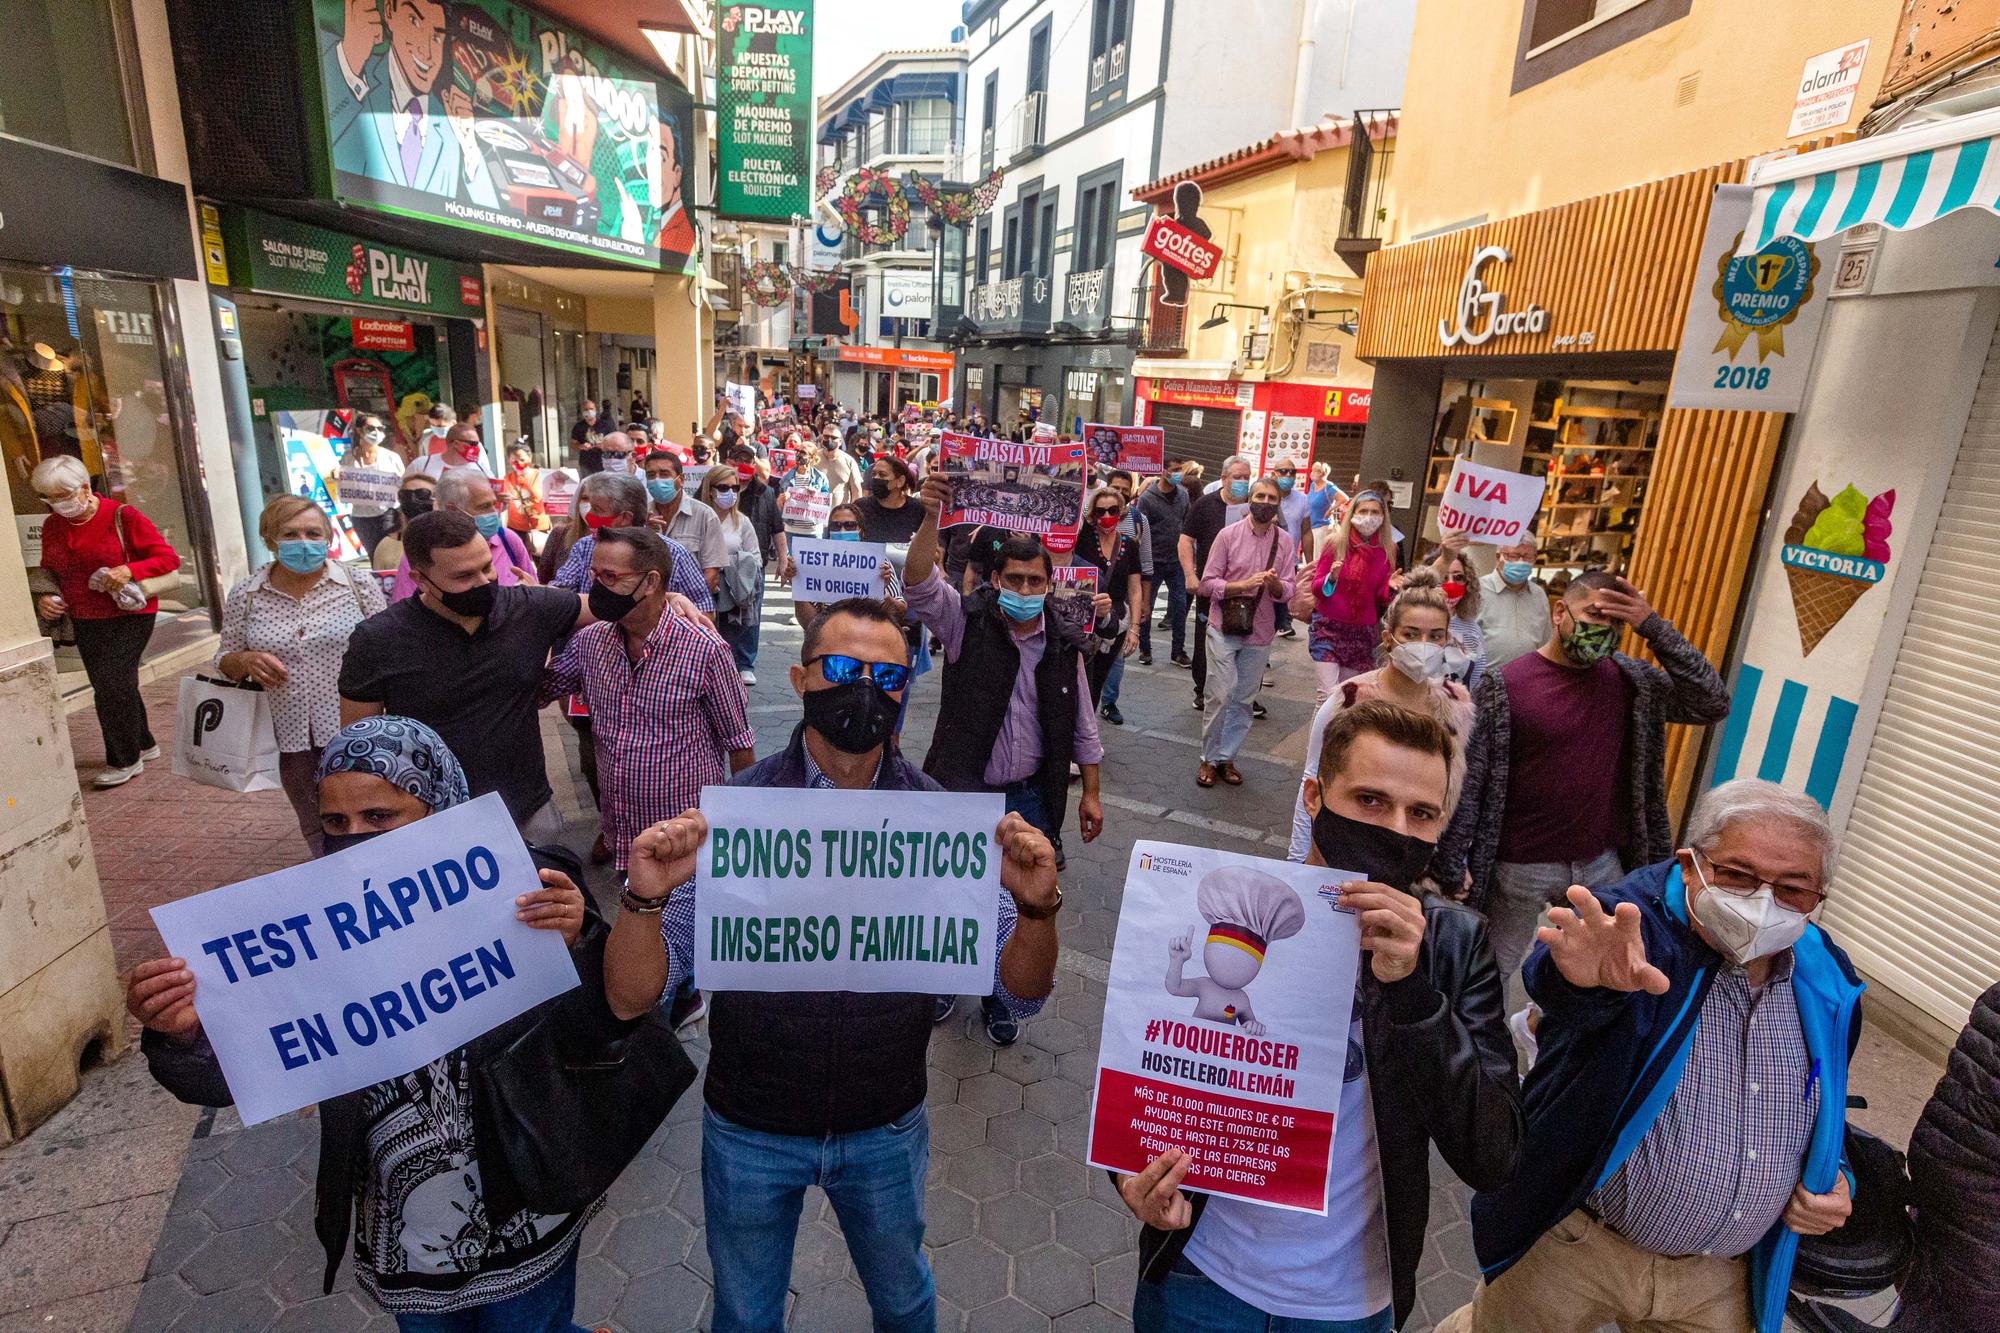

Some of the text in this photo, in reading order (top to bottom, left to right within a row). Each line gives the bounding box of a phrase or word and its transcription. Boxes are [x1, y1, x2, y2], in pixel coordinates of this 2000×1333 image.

[744, 7, 805, 35] PLAY
[752, 23, 793, 35] LAND
[738, 52, 790, 68] APUESTAS
[731, 66, 796, 81] DEPORTIVAS
[1802, 68, 1849, 94] alarm
[731, 79, 796, 95] SPORTS BETTING
[735, 102, 791, 121] MÁQUINAS
[734, 119, 793, 135] DE PREMIO
[732, 132, 793, 147] SLOT MACHINES
[728, 167, 798, 186] ELECTRÓNICA
[743, 158, 782, 172] RULETA
[743, 184, 782, 198] ROULETTE
[444, 201, 486, 222] MÁQUINAS
[486, 211, 496, 223] DE
[496, 213, 521, 229] PREMIO
[526, 219, 555, 237] APUESTAS
[555, 225, 589, 244] DEPORTIVAS
[291, 245, 303, 258] DE
[303, 246, 328, 263] JUEGO
[1154, 226, 1215, 269] gofres
[268, 255, 326, 275] SLOT MACHINES
[369, 248, 428, 304] PLAY
[1794, 251, 1808, 291] ESPAÑA
[1843, 258, 1865, 283] 25
[380, 279, 422, 303] LAND
[1731, 292, 1790, 309] PREMIO
[359, 320, 404, 333] Ladbrokes
[1067, 371, 1098, 393] OUTLET
[1163, 380, 1184, 392] Gofres
[1184, 380, 1222, 394] Manneken
[1223, 382, 1236, 395] Pis
[1713, 365, 1771, 391] 2018
[1142, 434, 1158, 445] YA!
[974, 439, 1025, 465] ¡BASTA
[1028, 445, 1052, 466] YA!
[339, 487, 396, 503] SEGURIDAD SOCIAL
[1454, 471, 1508, 505] IVA
[963, 508, 1052, 533] NOS ARRUINAN
[1440, 504, 1521, 537] EDUCIDO
[799, 550, 877, 570] TEST RÁPIDO
[1786, 547, 1878, 581] VICTORIA
[1063, 567, 1077, 582] YA!
[806, 577, 870, 596] EN ORIGEN
[710, 818, 988, 880] BONOS TURÍSTICOS
[1152, 864, 1188, 877] DE ESPAÑA
[1153, 856, 1193, 869] HOSTELERÍA
[202, 845, 501, 985] TEST RÁPIDO
[710, 914, 979, 966] IMSERSO FAMILIAR
[268, 938, 517, 1072] EN ORIGEN
[1144, 1019, 1299, 1071] #YOQUIEROSER
[1141, 1050, 1295, 1099] HOSTELEROALEMÁN
[1134, 1085, 1296, 1129] MÁS DE 10.000 MILLONES DE € DE
[1144, 1104, 1280, 1141] AYUDAS EN ESTE MOMENTO.
[1130, 1118, 1290, 1159] AYUDAS DE HASTA EL 75% DE LAS
[1188, 1146, 1201, 1160] DE
[1203, 1148, 1221, 1163] LAS
[1223, 1151, 1277, 1173] EMPRESAS
[1203, 1164, 1223, 1179] POR
[1226, 1168, 1266, 1187] CIERRES
